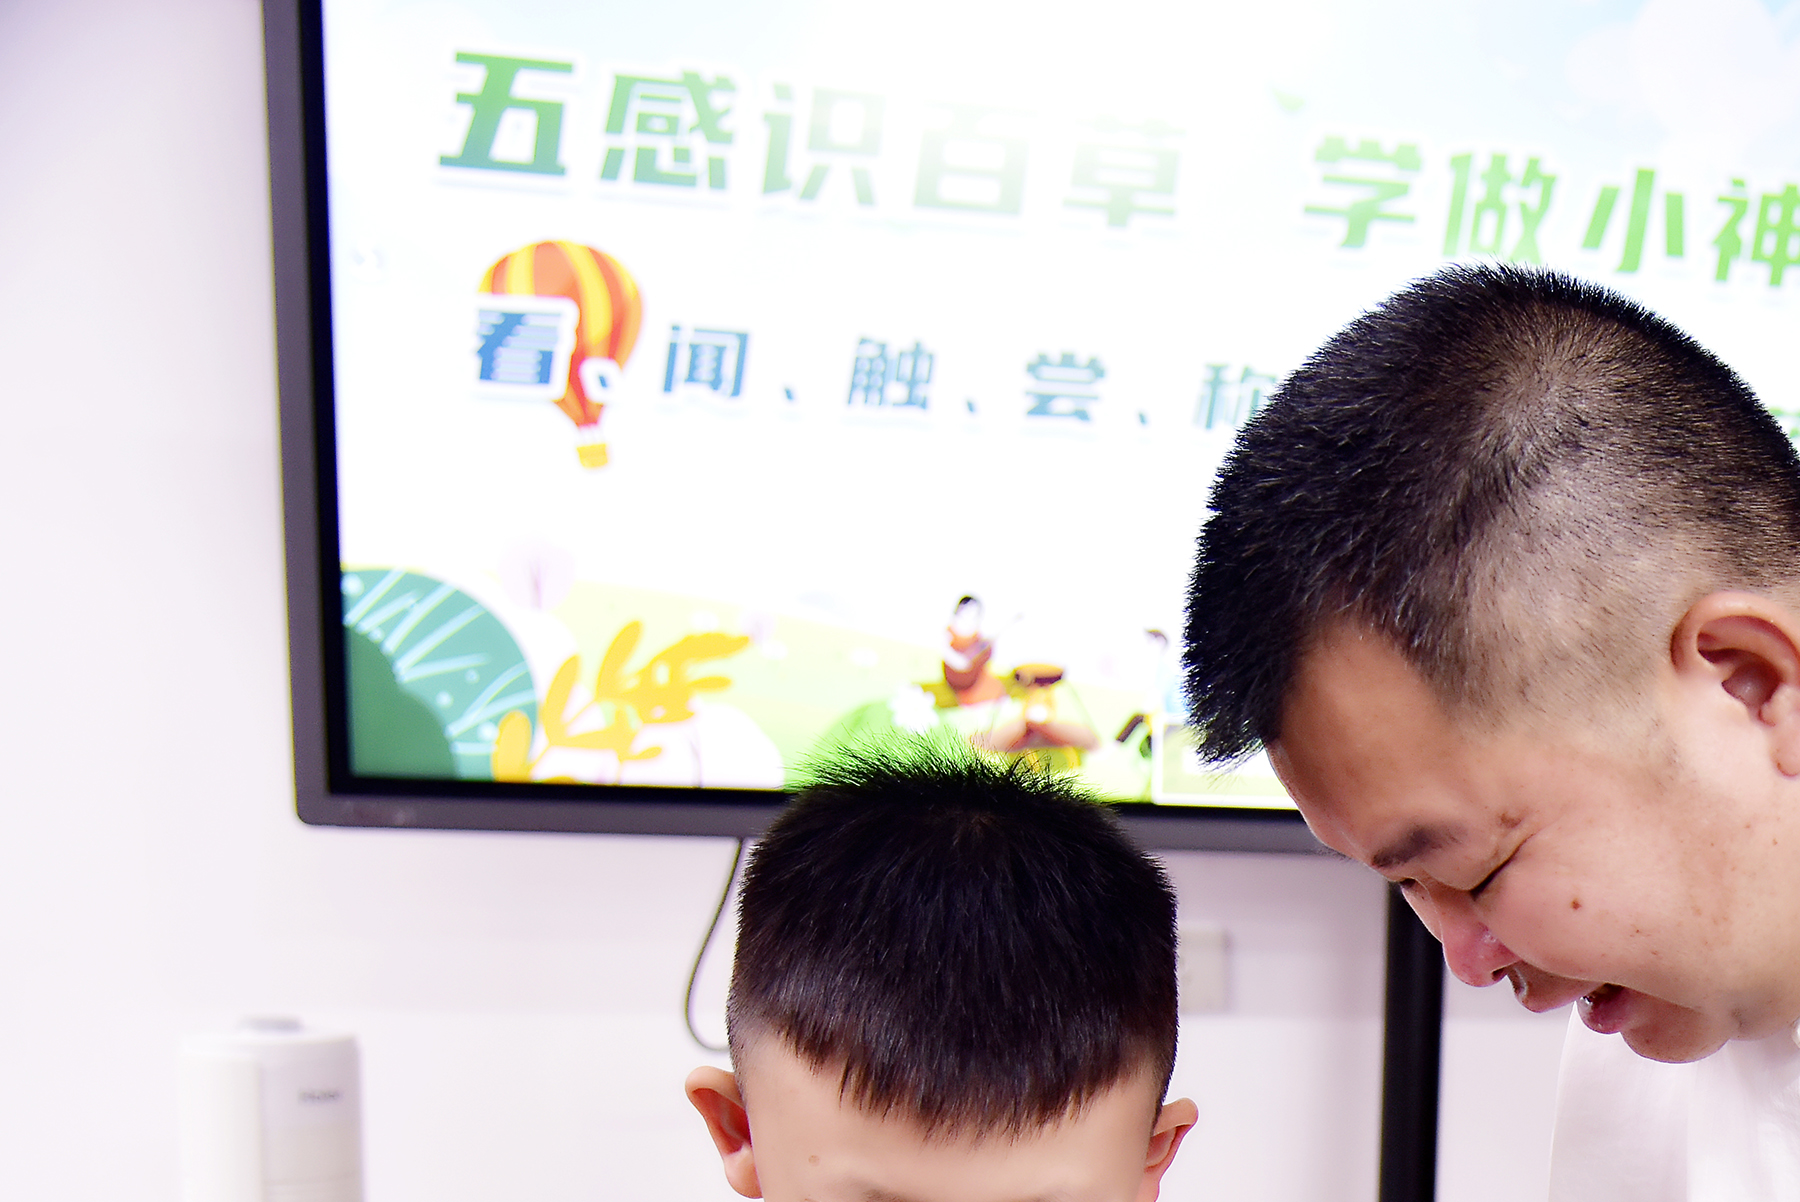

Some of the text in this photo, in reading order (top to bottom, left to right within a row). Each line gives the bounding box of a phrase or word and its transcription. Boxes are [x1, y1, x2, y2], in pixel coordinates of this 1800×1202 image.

[439, 51, 1188, 228] 五感识百草
